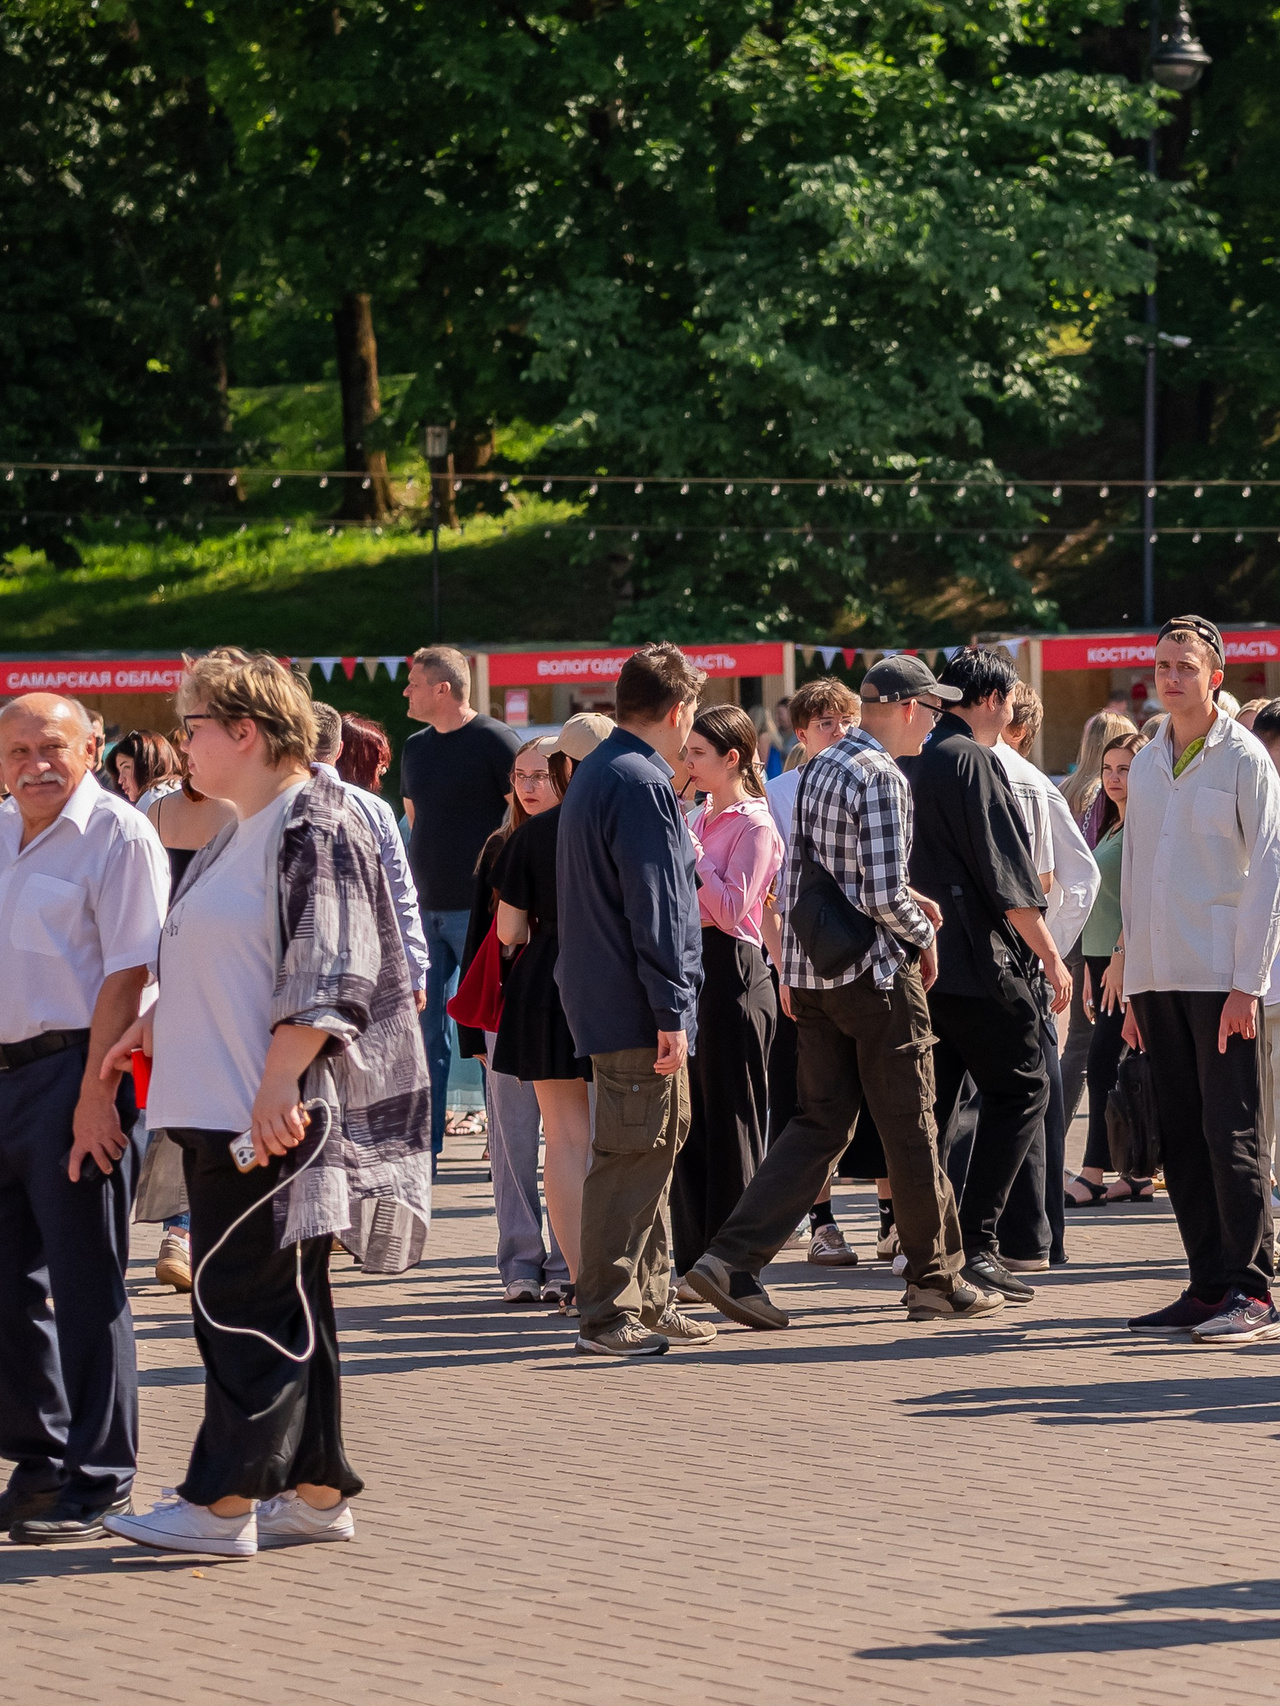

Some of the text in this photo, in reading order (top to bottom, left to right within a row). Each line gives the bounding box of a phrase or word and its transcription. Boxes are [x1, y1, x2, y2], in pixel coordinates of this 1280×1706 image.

[1087, 641, 1278, 662] КОСТРОМ ЛАСТЬ
[537, 658, 626, 676] ВОЛОГОДС
[7, 670, 186, 688] САМАРСКАЯ ОБЛАСТ
